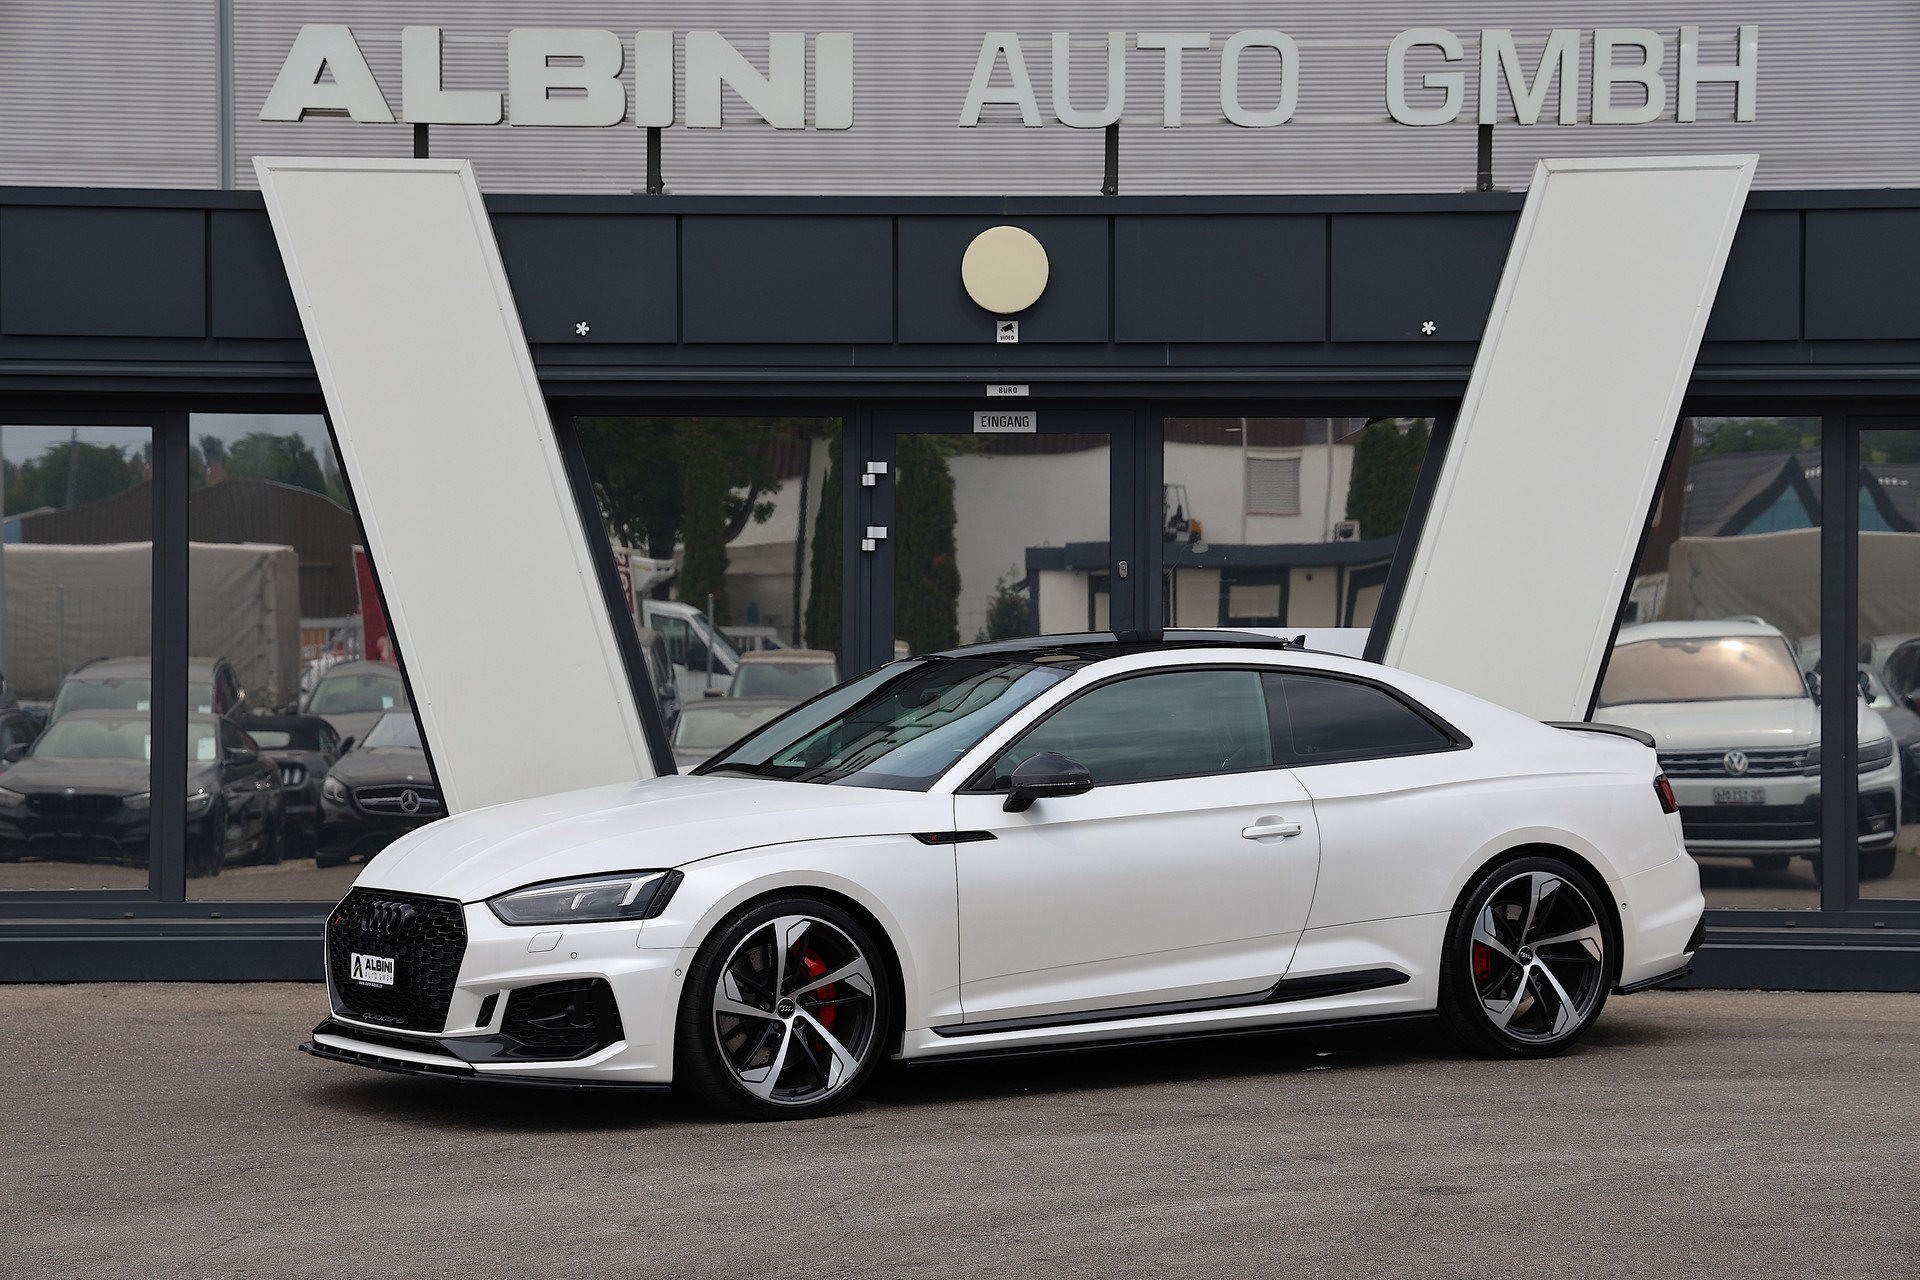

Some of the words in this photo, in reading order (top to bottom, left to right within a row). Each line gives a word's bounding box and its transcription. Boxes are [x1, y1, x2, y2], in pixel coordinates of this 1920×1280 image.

[259, 24, 854, 130] ALBINI
[958, 29, 1300, 129] AUTO
[1385, 25, 1759, 127] GMBH
[998, 386, 1018, 394] BÜRO
[981, 415, 1030, 428] EINGANG
[365, 958, 393, 973] ALBINI
[365, 971, 378, 980] AUTO
